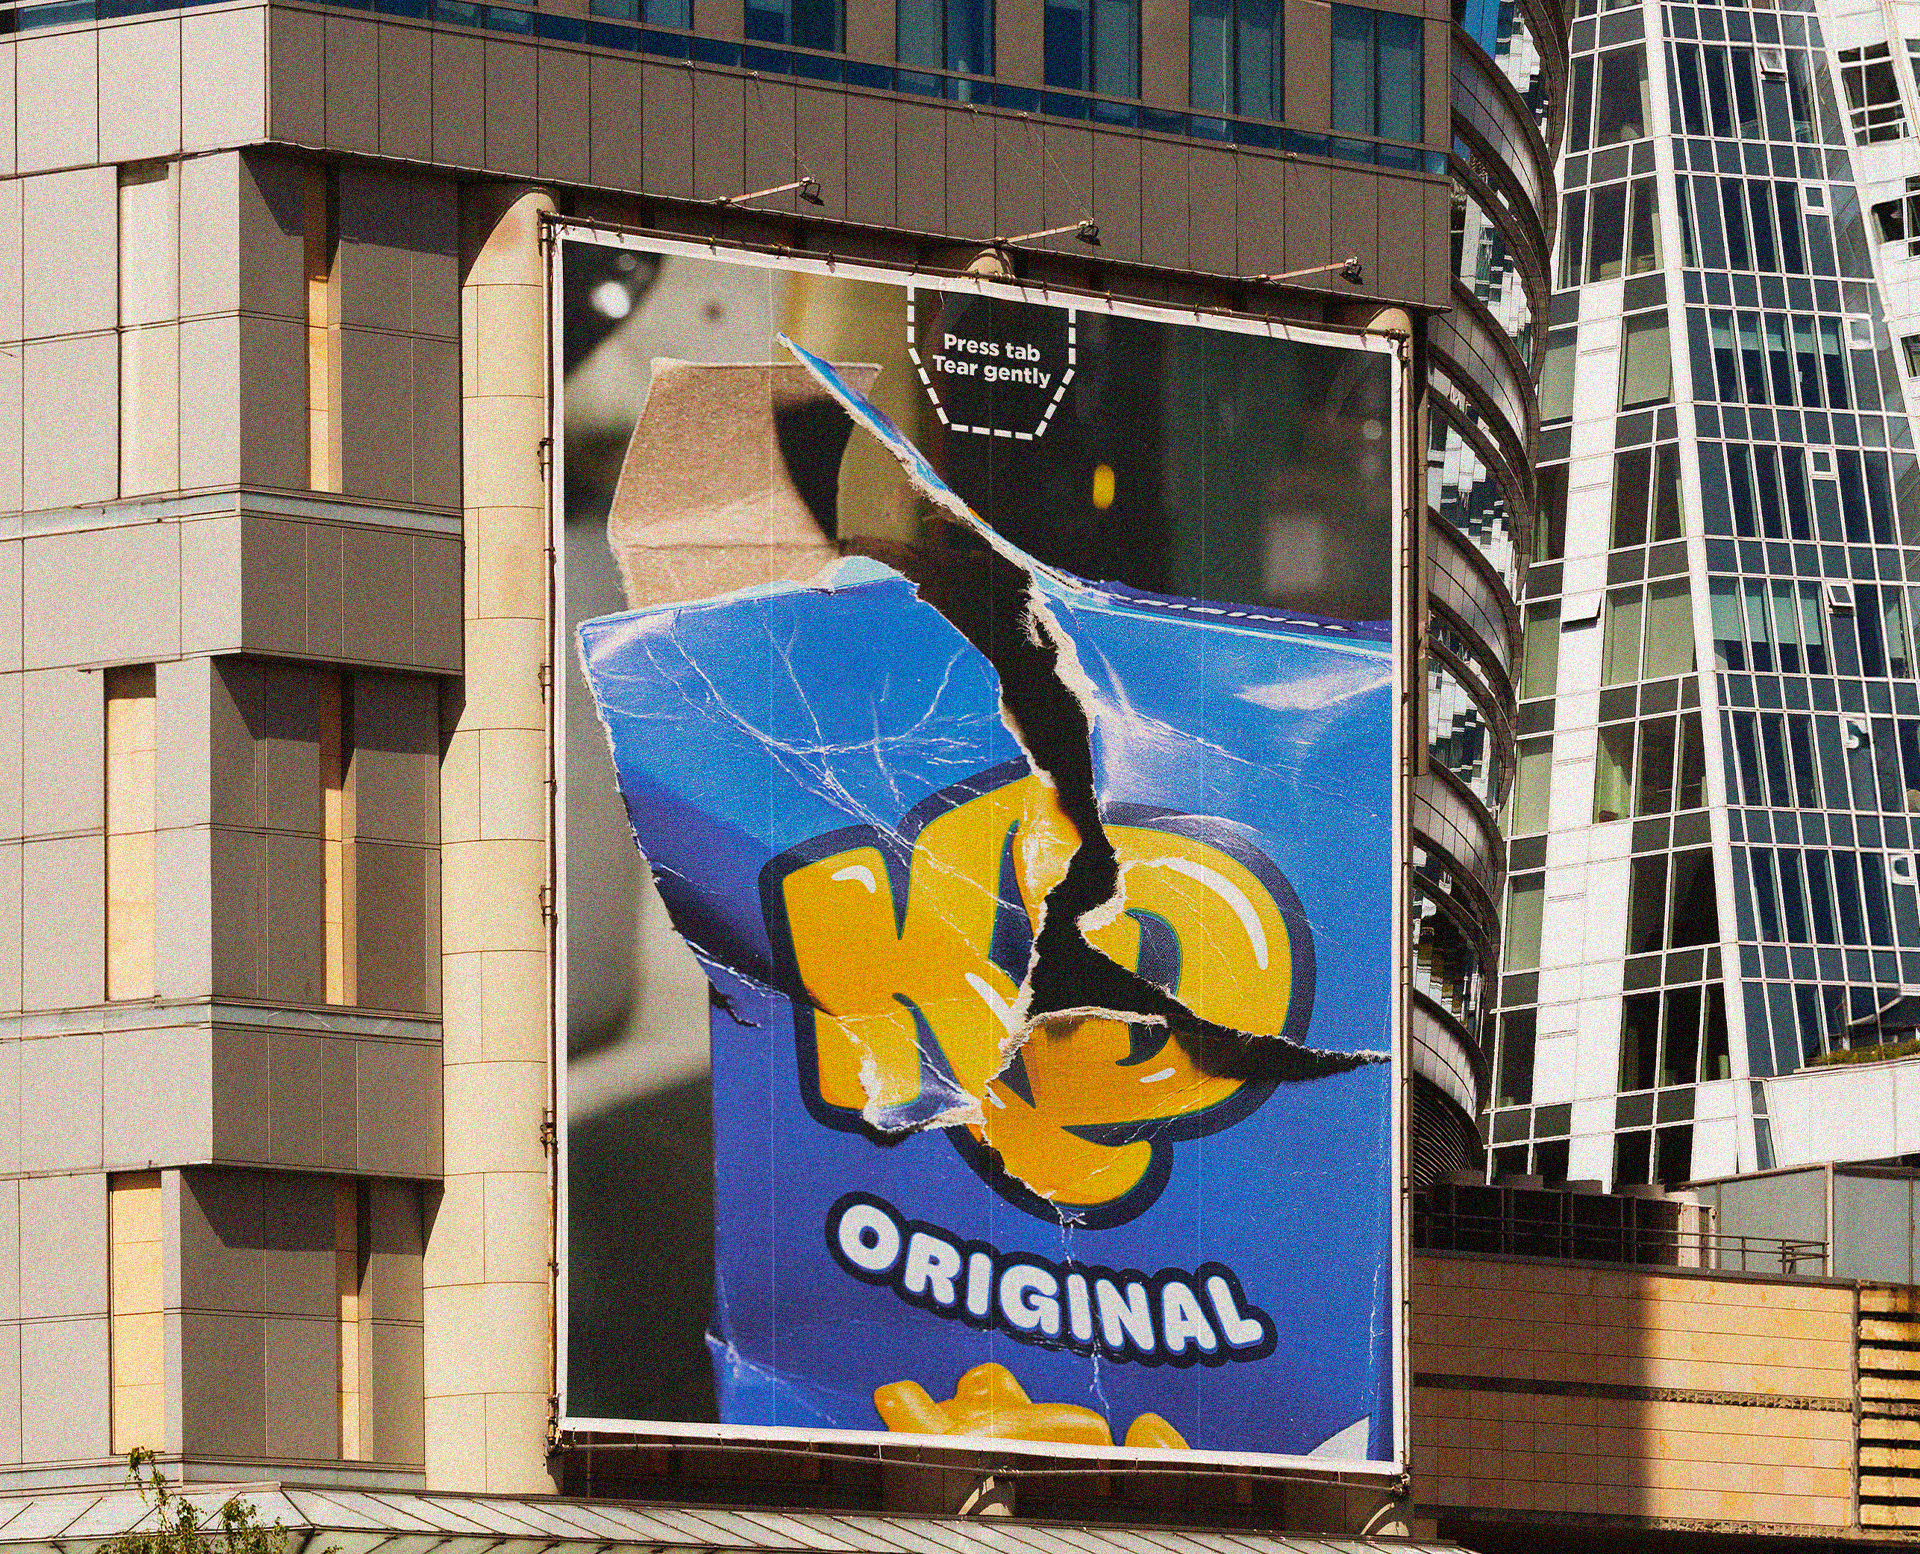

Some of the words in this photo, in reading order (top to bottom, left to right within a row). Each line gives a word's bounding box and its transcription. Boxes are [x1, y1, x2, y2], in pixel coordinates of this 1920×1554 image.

[944, 333, 1000, 357] Press
[1005, 342, 1041, 362] tab
[932, 354, 979, 377] Tear
[983, 365, 1052, 389] gently
[837, 1203, 1264, 1352] ORIGINAL
